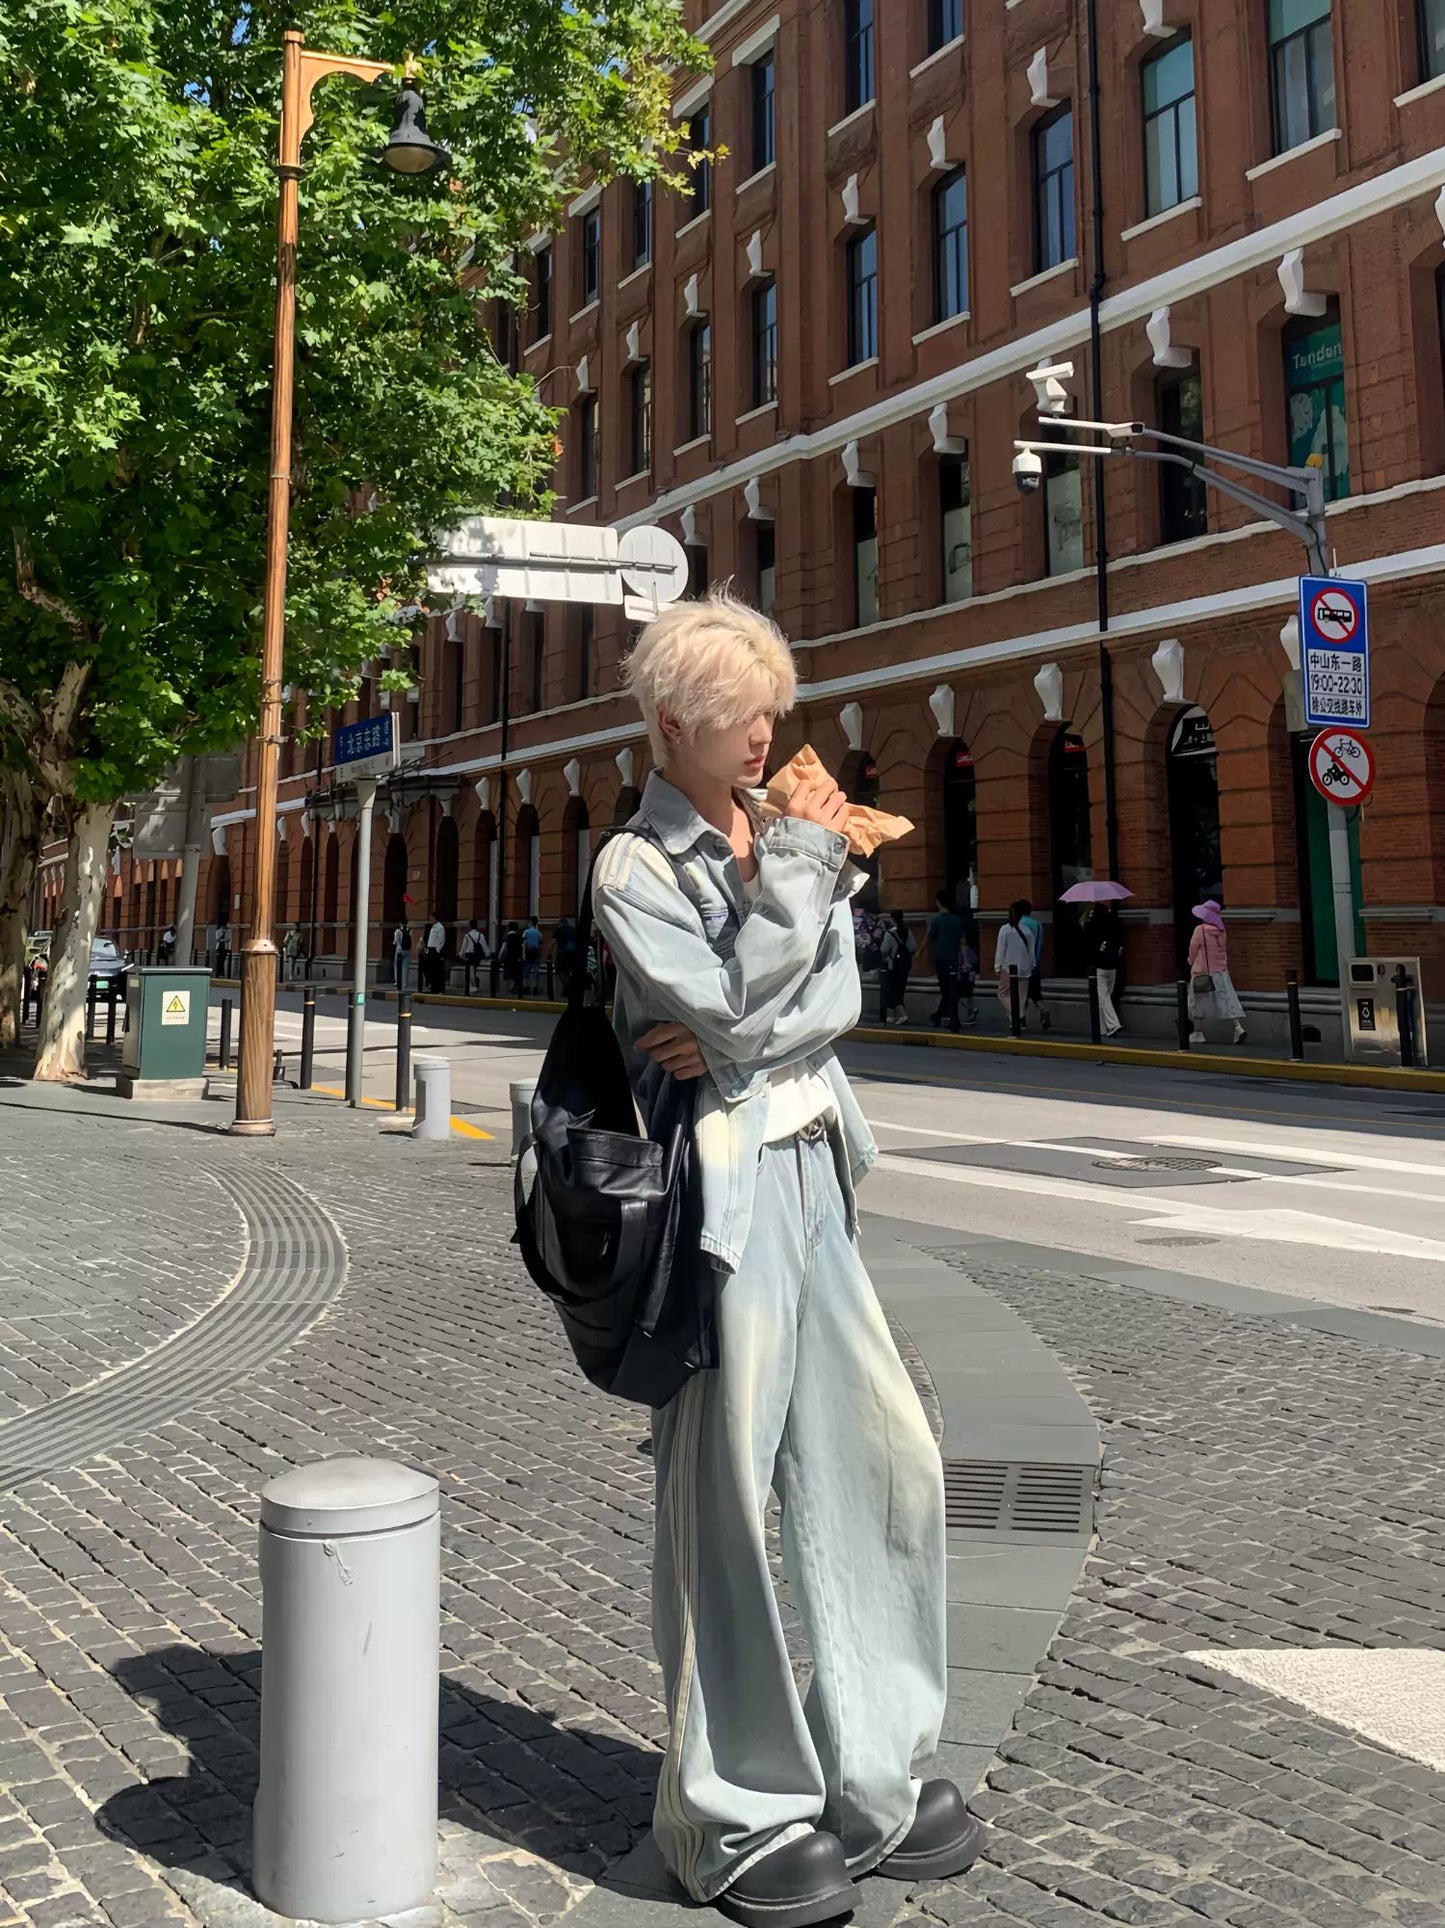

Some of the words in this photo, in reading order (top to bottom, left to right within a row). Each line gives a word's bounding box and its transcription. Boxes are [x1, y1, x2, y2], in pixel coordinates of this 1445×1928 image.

[1310, 651, 1362, 672] 中山东一路
